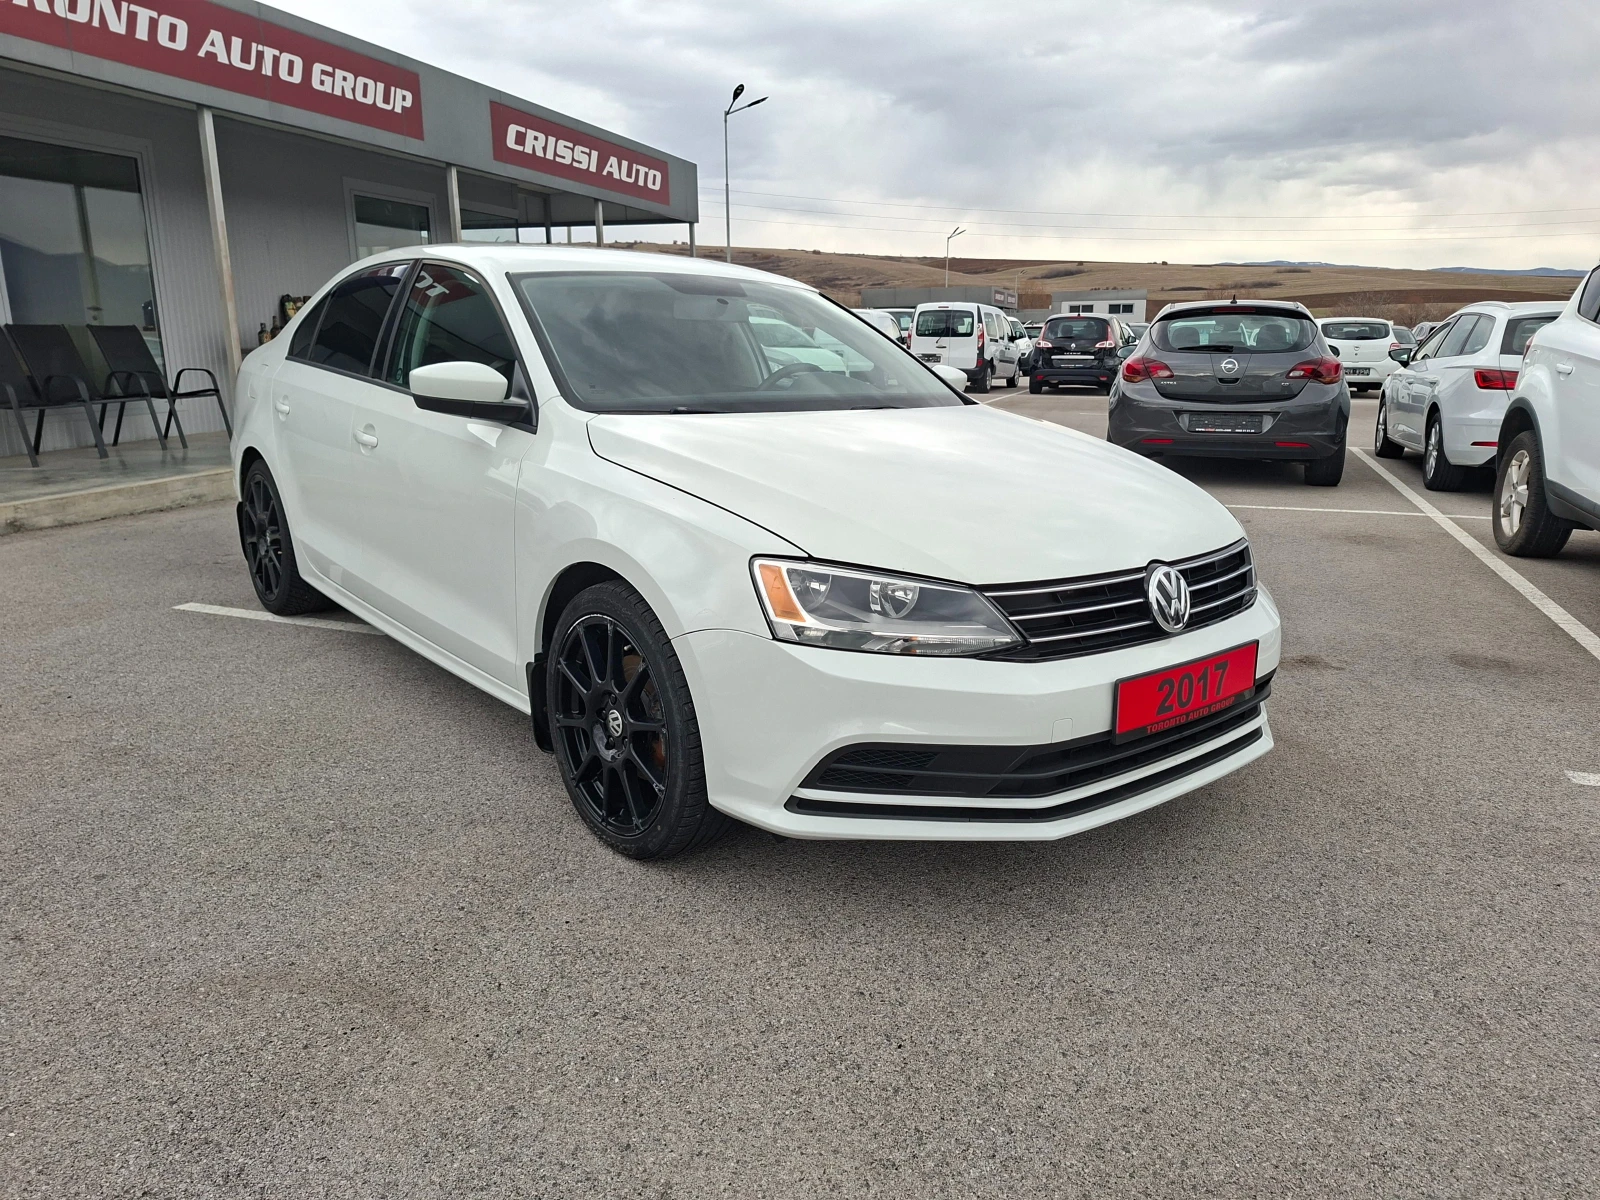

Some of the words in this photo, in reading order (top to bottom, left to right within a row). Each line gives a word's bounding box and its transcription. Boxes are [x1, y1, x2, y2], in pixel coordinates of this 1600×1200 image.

[198, 29, 303, 84] AUTO
[312, 62, 412, 113] GROUP
[506, 123, 598, 172] CRISSI
[602, 156, 661, 191] AUTO
[1147, 714, 1186, 734] TORONTO
[1188, 707, 1209, 721] AUTO
[1211, 697, 1235, 713] GROUP
[1156, 660, 1229, 716] 2017
